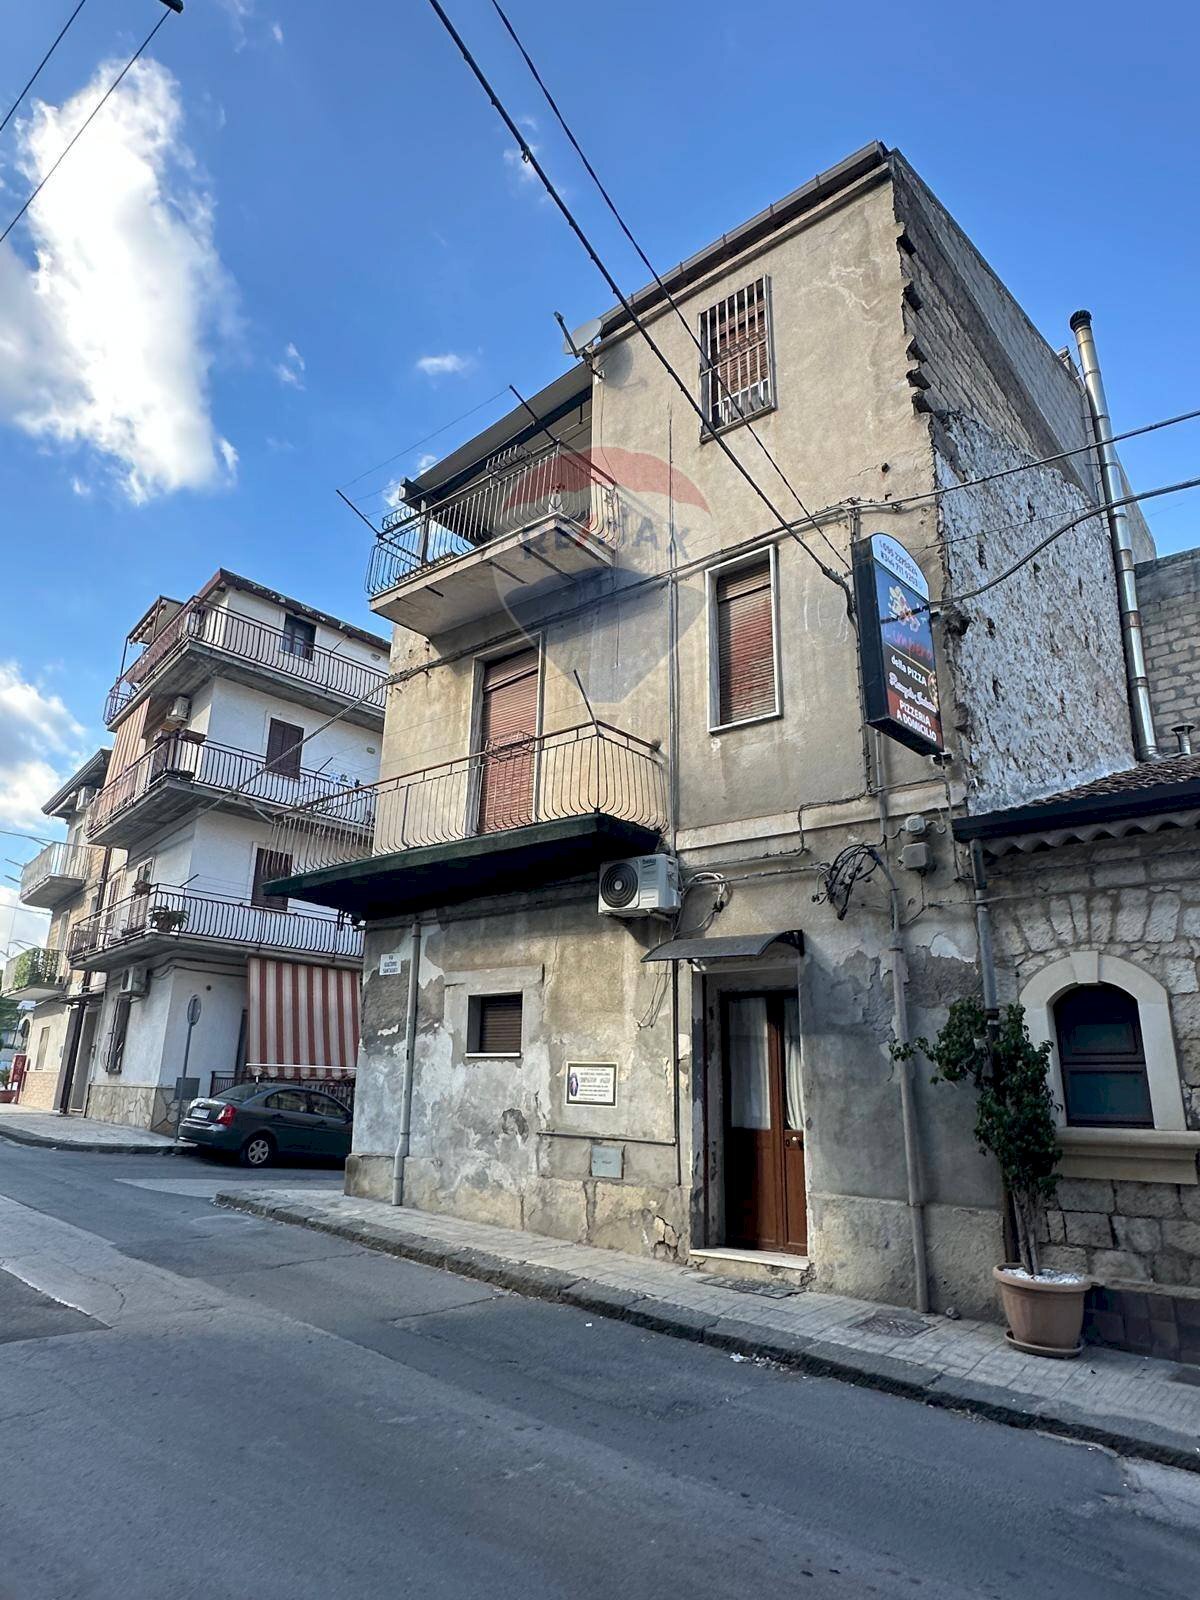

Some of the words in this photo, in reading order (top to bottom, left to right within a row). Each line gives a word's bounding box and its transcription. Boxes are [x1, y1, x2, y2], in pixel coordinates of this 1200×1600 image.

[890, 654, 907, 673] della
[907, 665, 928, 687] PIZZA
[896, 708, 903, 721] A
[902, 714, 937, 742] DOMICILIO
[899, 699, 931, 727] PIZZERIA
